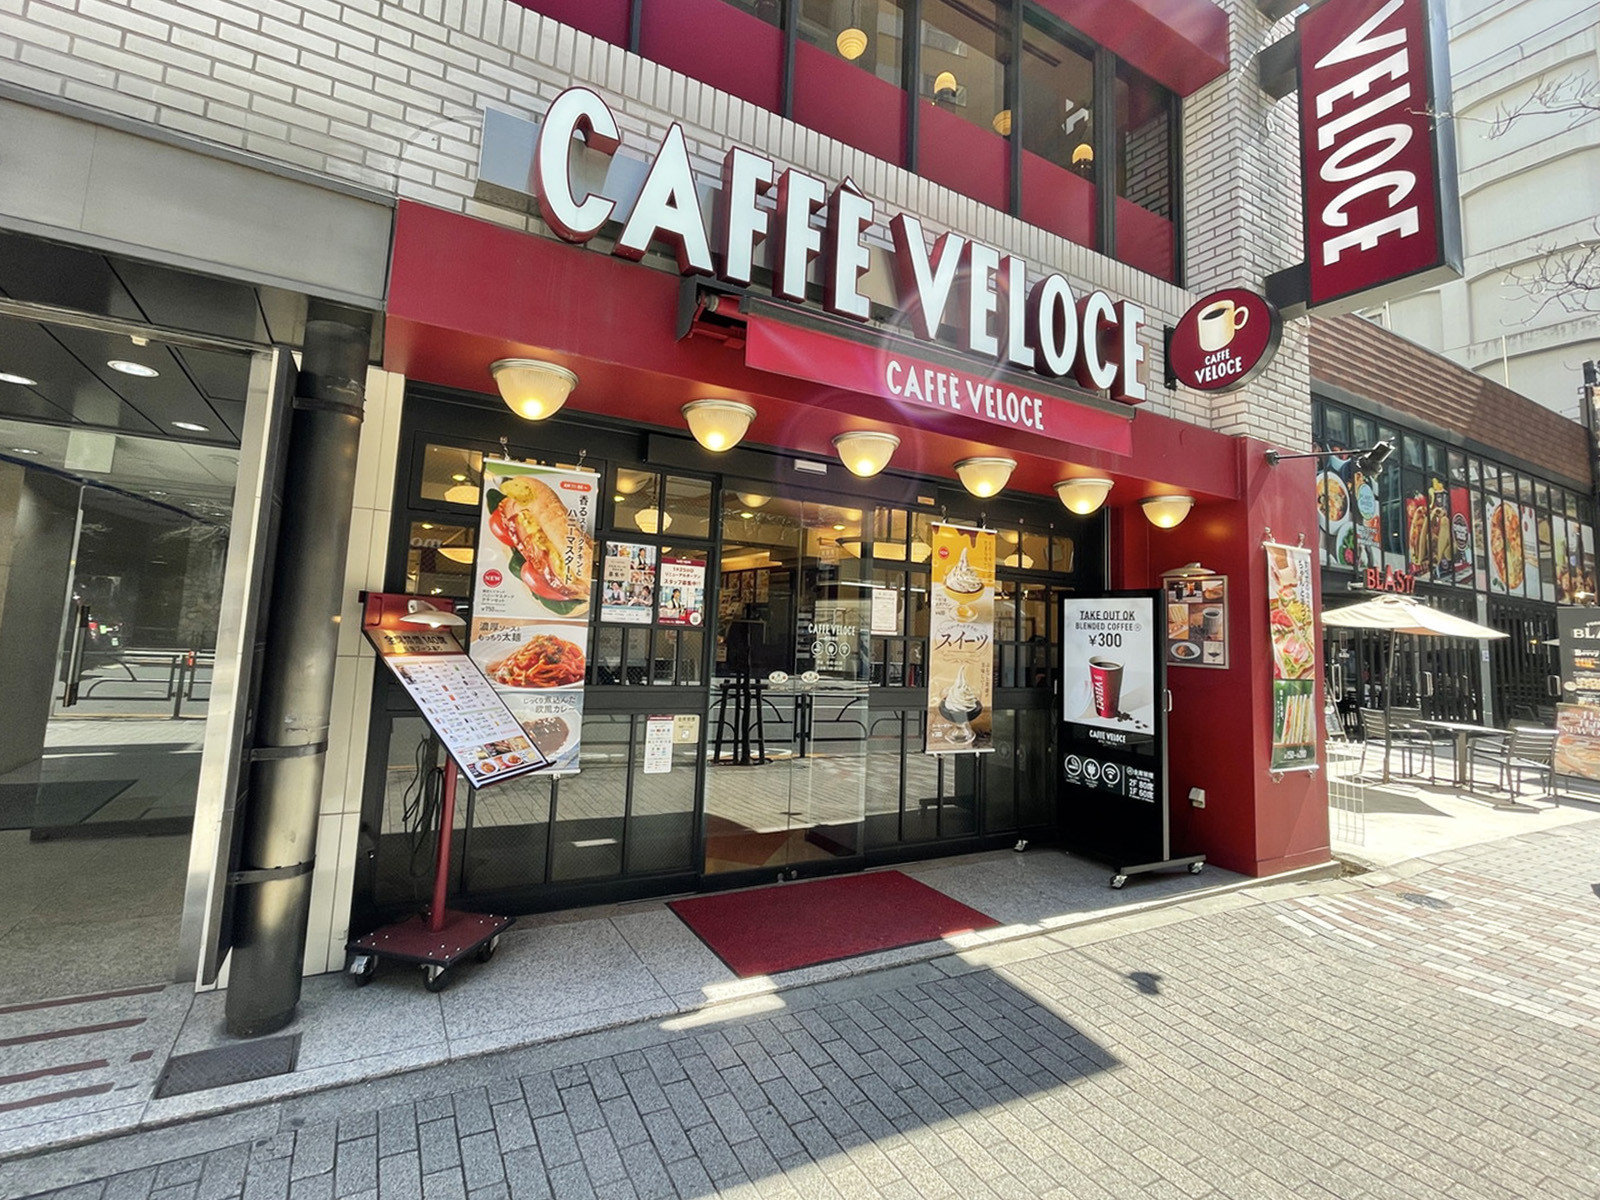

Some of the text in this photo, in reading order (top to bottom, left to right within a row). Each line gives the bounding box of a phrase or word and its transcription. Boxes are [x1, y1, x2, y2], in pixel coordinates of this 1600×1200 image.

[1314, 0, 1419, 266] VELOCE
[890, 212, 1147, 404] VELOCE
[1194, 356, 1242, 385] VELOCE
[886, 360, 1044, 431] CAFFÈ VELOCE
[564, 509, 577, 585] ハニーマスタード
[1075, 622, 1134, 631] BLENDED COFFEE
[1080, 610, 1135, 621] TAKE OUT OK
[935, 631, 989, 651] スイーツ
[1088, 632, 1122, 647] ¥300
